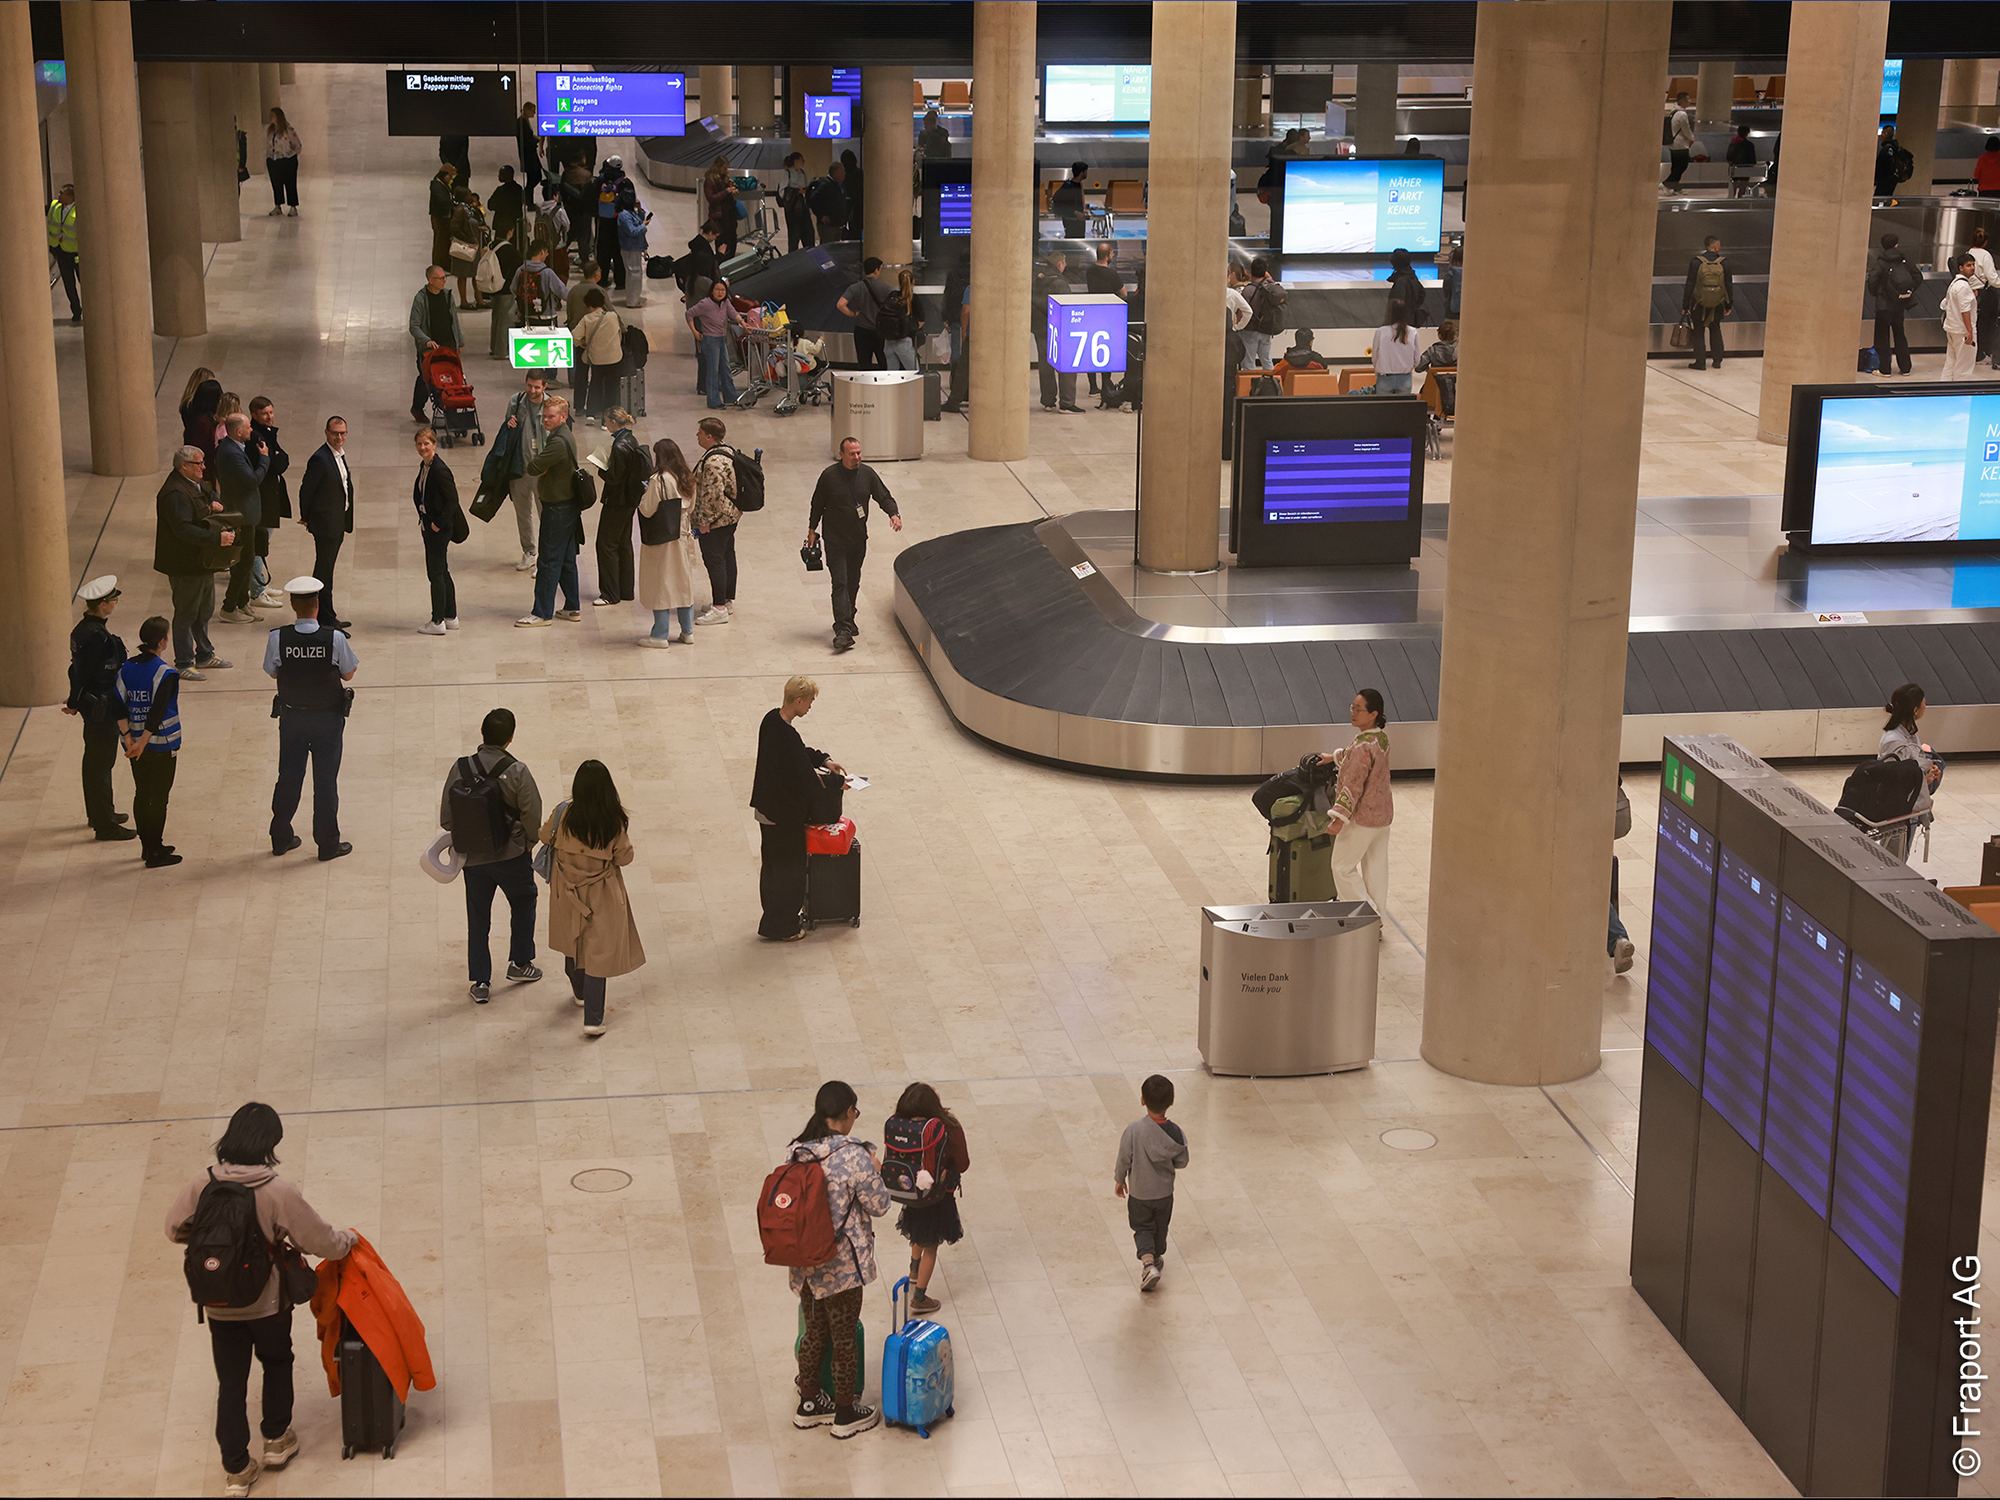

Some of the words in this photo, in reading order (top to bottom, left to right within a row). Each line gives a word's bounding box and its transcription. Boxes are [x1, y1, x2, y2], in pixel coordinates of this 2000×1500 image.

[423, 75, 475, 83] Gepäckermittlung
[572, 76, 615, 84] Anschlussflüge
[423, 83, 448, 91] Baggage
[450, 83, 471, 91] tracing
[572, 84, 604, 92] Connecting
[605, 84, 623, 92] flights
[573, 98, 598, 106] Ausgang
[573, 119, 632, 127] Sperrgepäckausgabe
[815, 112, 840, 135] 75
[591, 127, 615, 135] baggage
[1389, 177, 1421, 187] NÄHER
[1389, 190, 1423, 202] PARKT
[1387, 205, 1420, 214] KEINER
[1049, 323, 1058, 363] 76
[1069, 330, 1110, 367] 76
[285, 646, 326, 659] POLIZEI
[1241, 972, 1267, 981] Vielen
[1269, 973, 1290, 981] Dank
[1241, 984, 1265, 993] Thank
[1266, 985, 1282, 995] you
